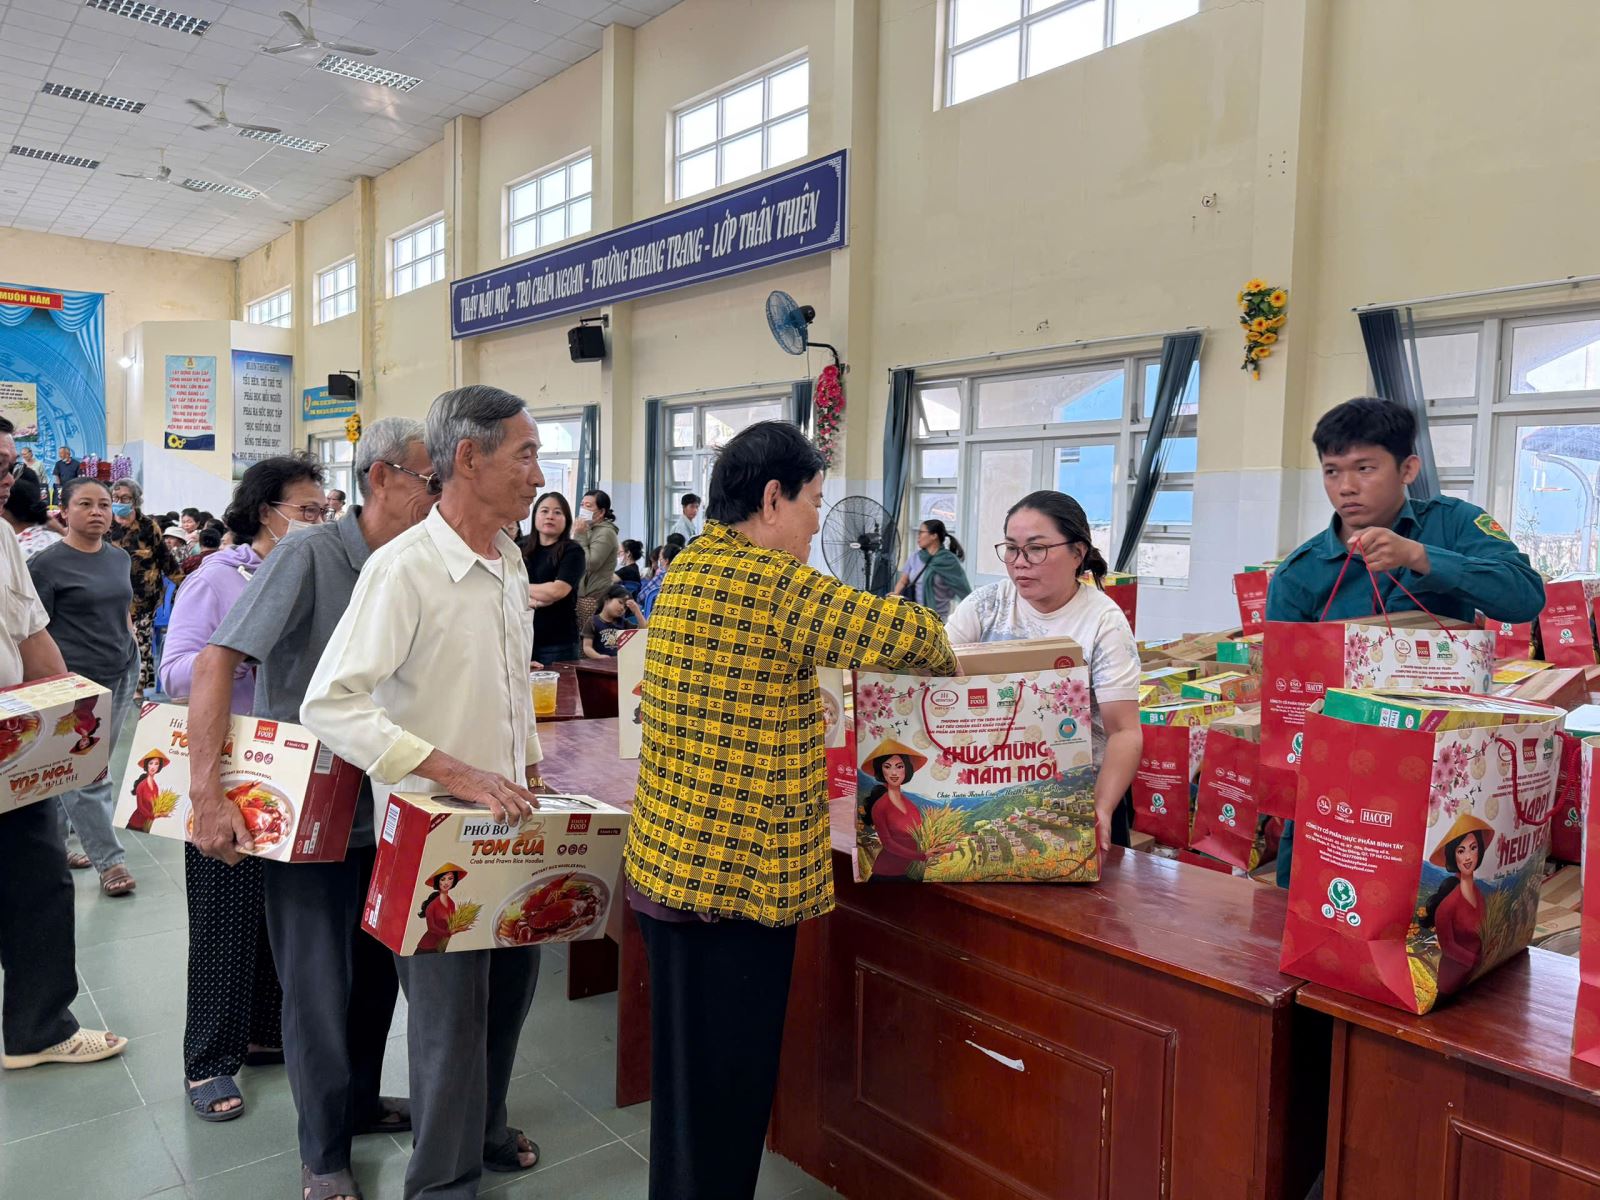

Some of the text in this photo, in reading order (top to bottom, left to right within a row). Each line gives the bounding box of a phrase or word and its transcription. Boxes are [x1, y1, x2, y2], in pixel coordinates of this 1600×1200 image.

[554, 263, 586, 303] NGOAN
[591, 245, 630, 289] TRƯỜNG
[629, 239, 666, 281] KHANG
[667, 226, 705, 270] TRANG
[712, 208, 738, 258] LỚP
[738, 196, 776, 251] THÂN
[776, 182, 820, 245] THIỆN
[171, 731, 189, 748] TO
[1336, 804, 1354, 815] ISO
[1362, 811, 1391, 825] HACCP
[463, 822, 491, 836] PHỞ
[512, 837, 544, 856] CUA
[1376, 840, 1392, 848] BÌNH
